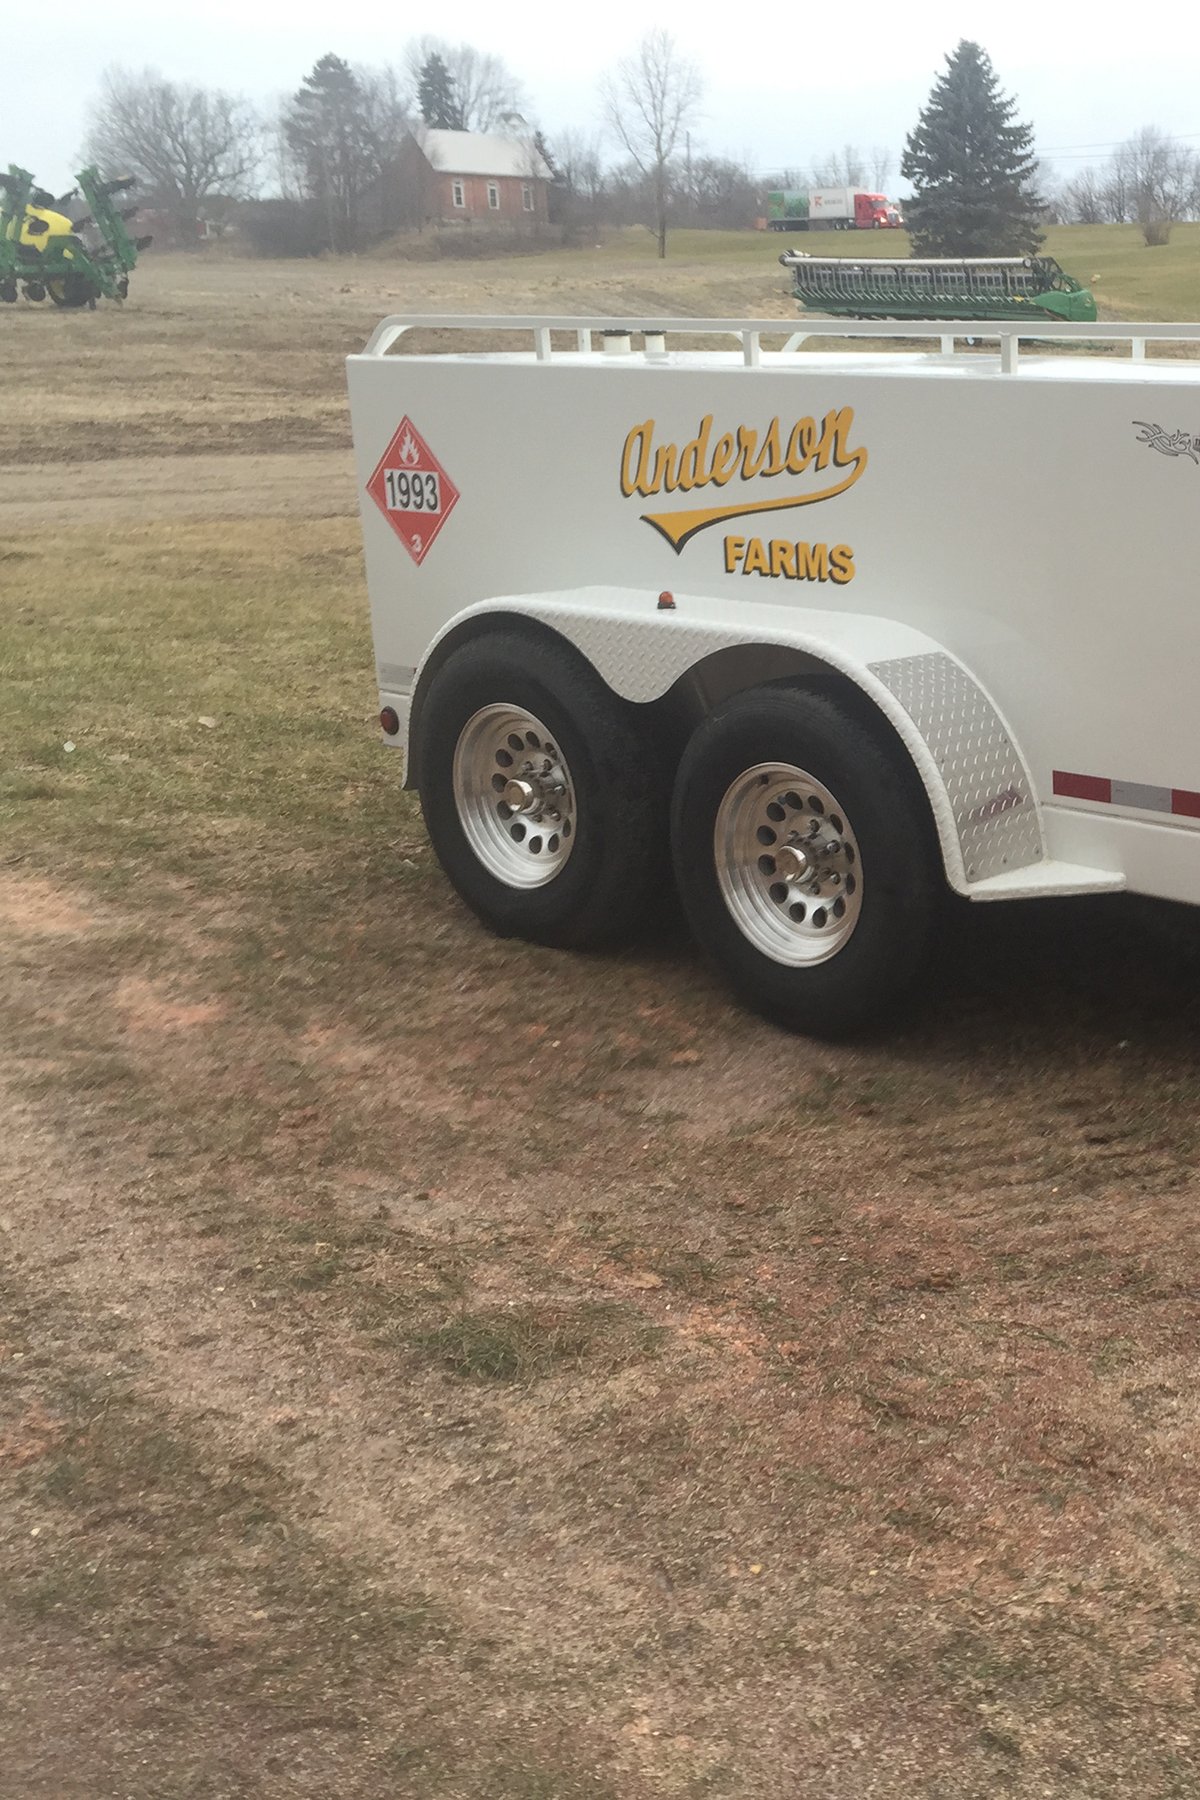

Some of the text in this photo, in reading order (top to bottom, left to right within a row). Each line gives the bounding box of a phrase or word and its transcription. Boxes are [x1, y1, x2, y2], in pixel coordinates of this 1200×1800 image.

[620, 405, 868, 498] Anderson
[386, 470, 439, 512] 1993
[410, 533, 423, 553] 3
[724, 534, 856, 584] FARMS
